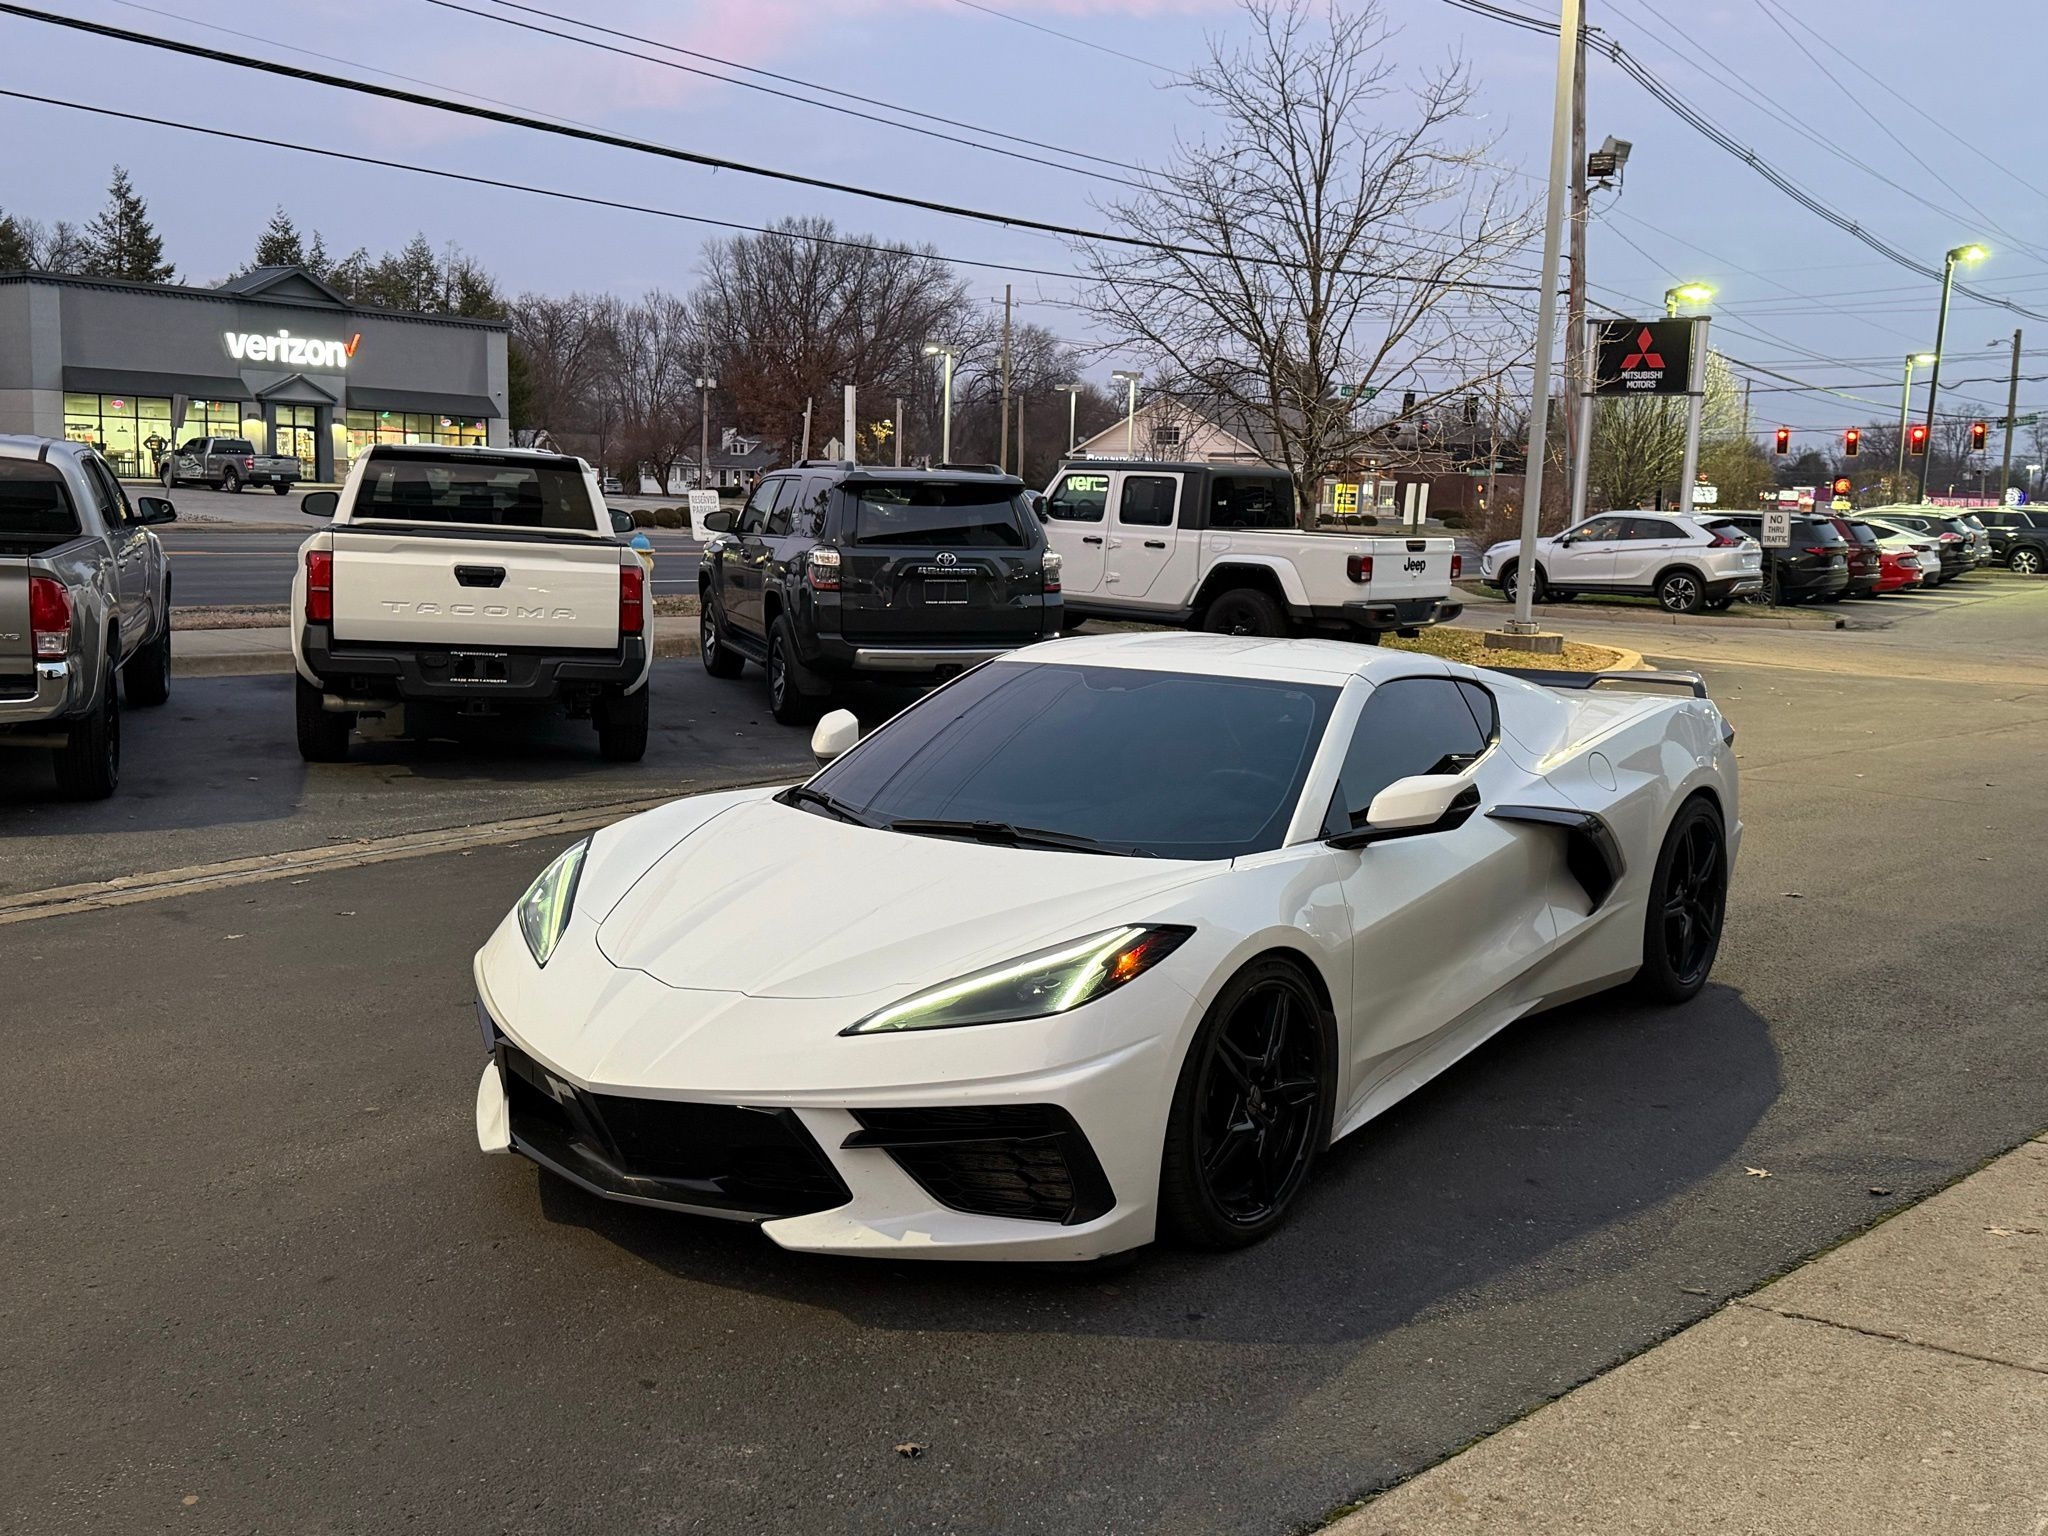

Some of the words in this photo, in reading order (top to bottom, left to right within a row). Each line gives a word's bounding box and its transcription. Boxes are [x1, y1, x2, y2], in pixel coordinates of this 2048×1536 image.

[223, 329, 347, 368] verizon
[1621, 371, 1663, 379] MITSUBISHI
[1626, 380, 1656, 389] MOTORS
[691, 495, 718, 504] RESERVED
[1770, 515, 1783, 524] NO
[1768, 526, 1784, 534] THRU
[1764, 535, 1787, 543] TRAFFIC
[1404, 557, 1426, 573] Jeep
[381, 600, 577, 619] TACOMA
